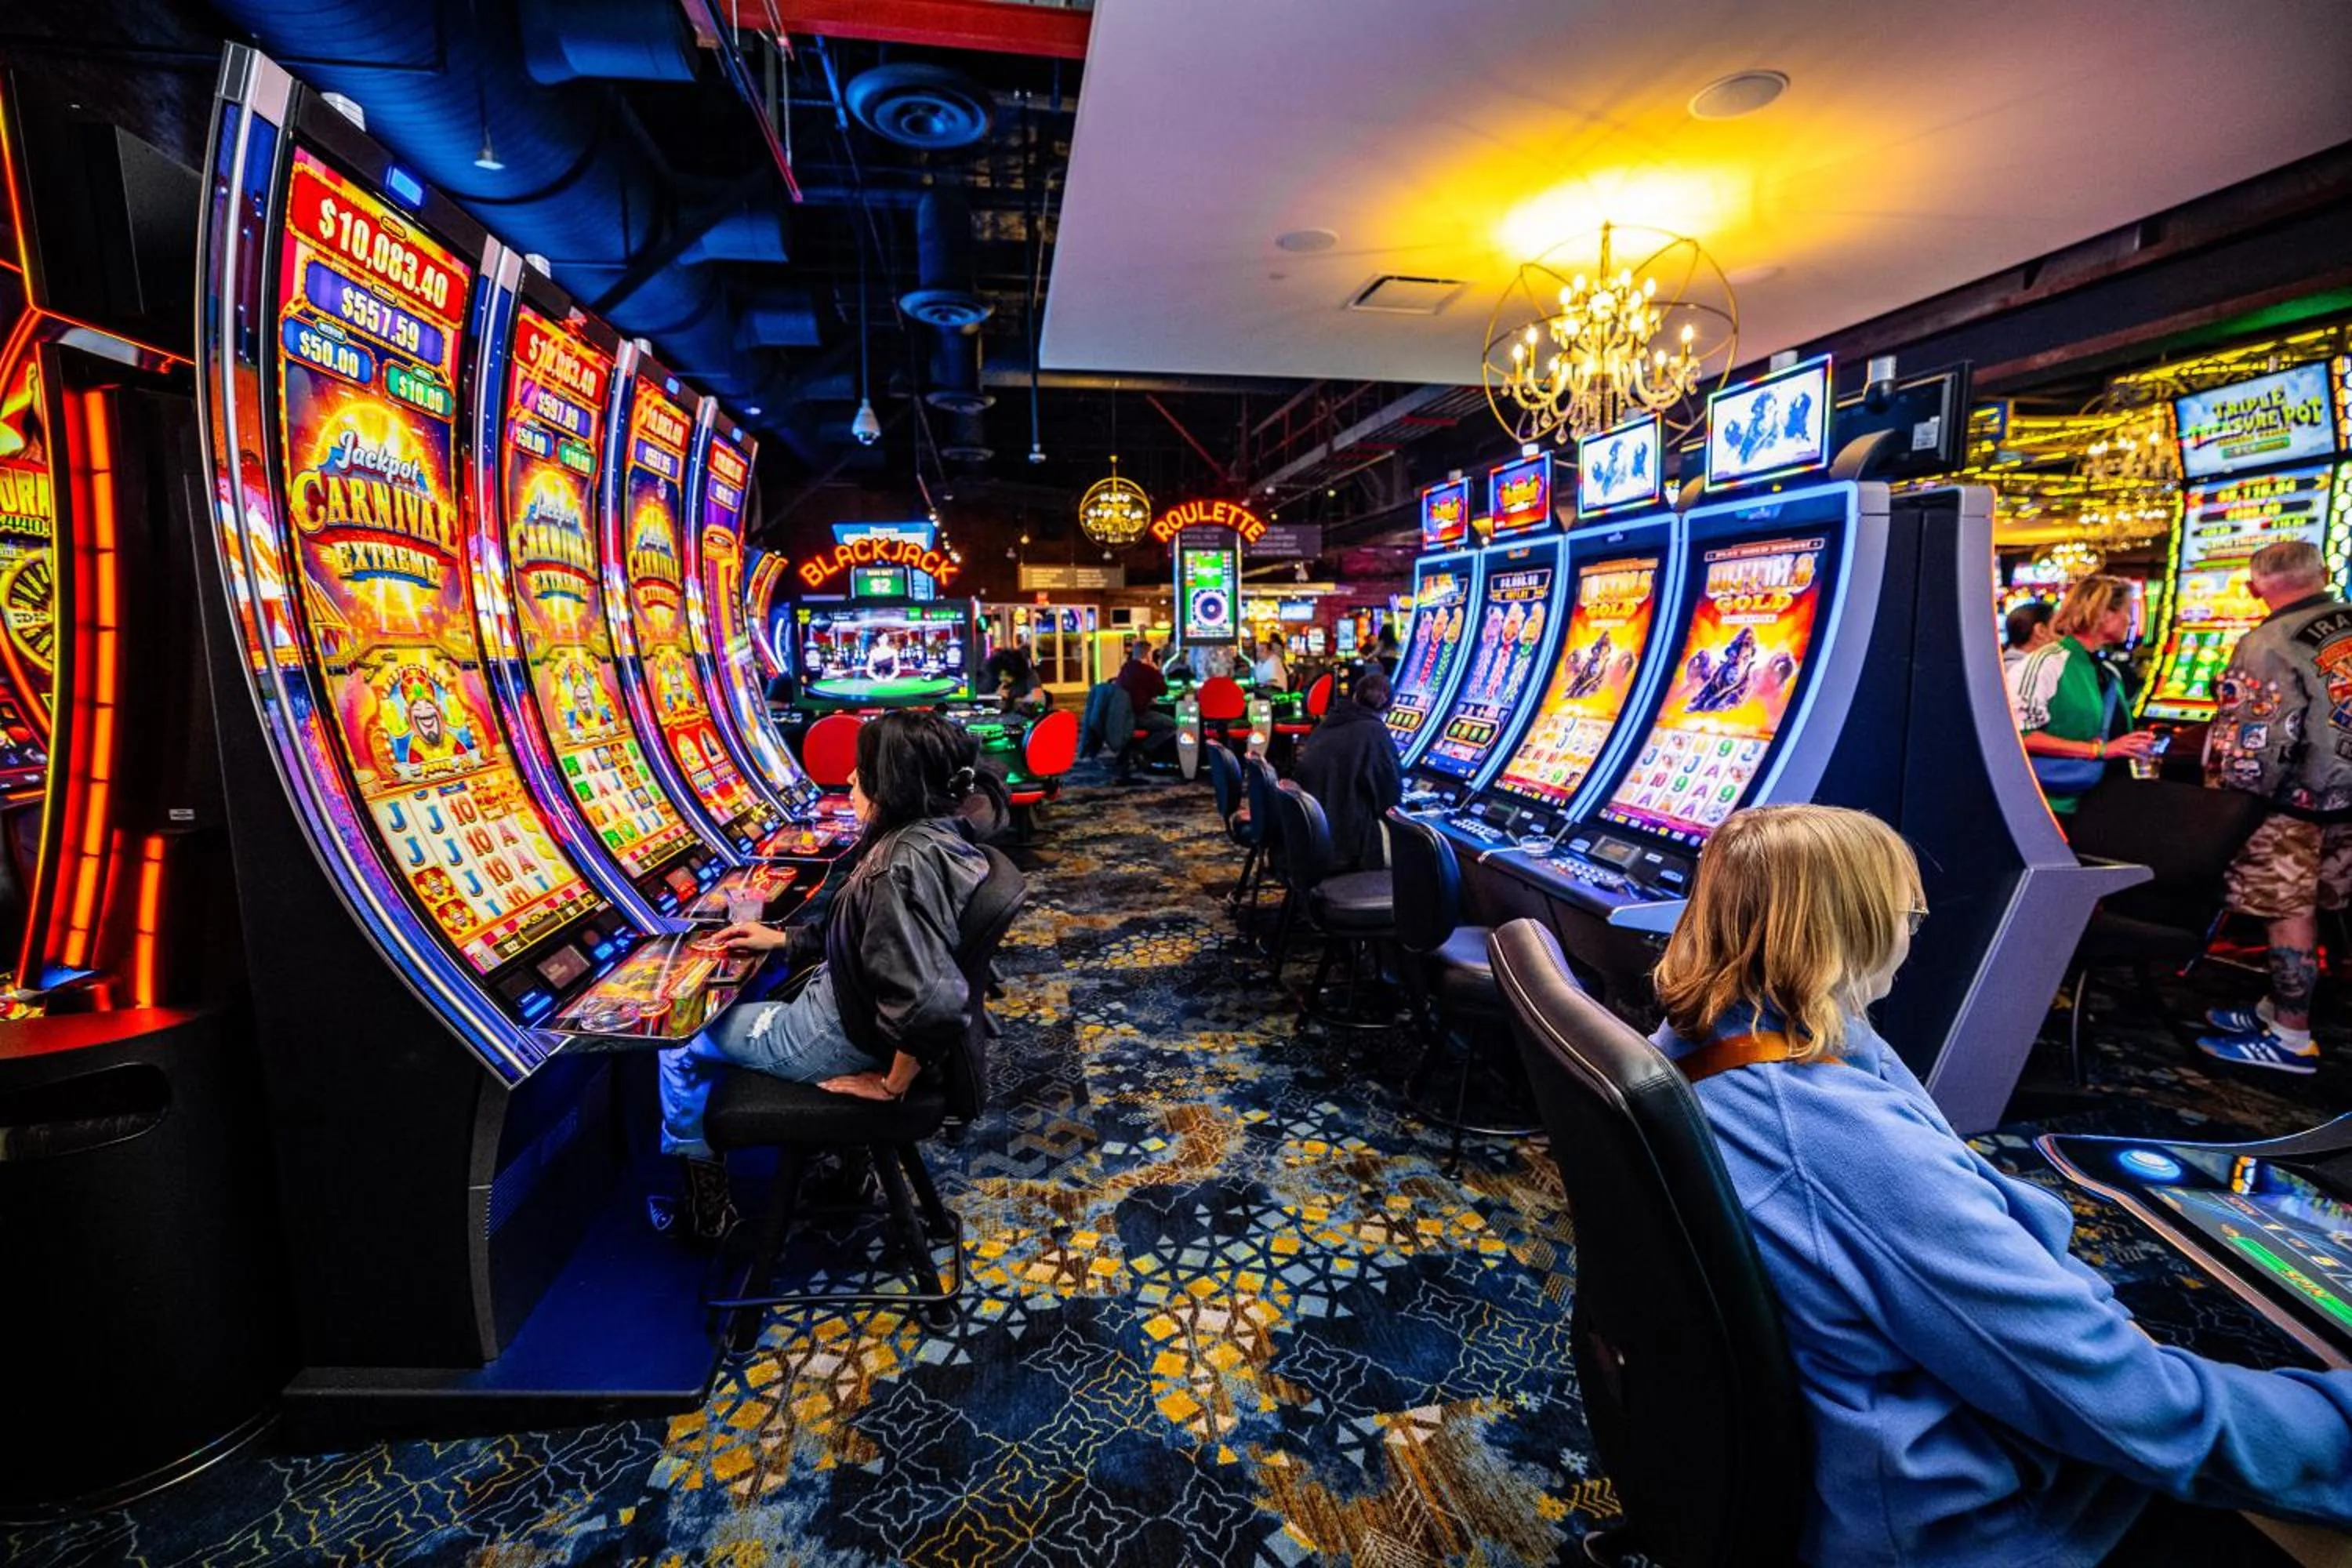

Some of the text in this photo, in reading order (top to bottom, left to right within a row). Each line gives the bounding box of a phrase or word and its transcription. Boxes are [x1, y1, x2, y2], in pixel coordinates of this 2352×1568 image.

[318, 198, 448, 310] $10,083.40
[341, 286, 420, 353] $557.59
[299, 330, 360, 379] $50.00
[398, 375, 445, 415] $10.00
[2212, 385, 2286, 419] TRIPLE
[2281, 395, 2323, 426] POT
[336, 430, 420, 483] Jackpot
[290, 470, 461, 558] CARNIVAL
[1152, 500, 1267, 543] ROULETTE
[332, 540, 441, 584] EXTREME
[799, 536, 960, 588] BLACKJACK
[1585, 602, 1638, 619] GOLD
[1714, 593, 1794, 615] GOLD
[1642, 748, 1720, 779] J J A
[1718, 739, 1734, 757] 9
[1637, 792, 1653, 807] A
[1650, 772, 1737, 804] 10 9 A 9
[387, 796, 477, 834] J J 10
[405, 836, 426, 867] J
[443, 837, 463, 866] J
[466, 826, 495, 857] 10
[498, 818, 519, 848] A
[463, 869, 484, 898] J
[484, 859, 514, 887] 10
[513, 849, 538, 876] A
